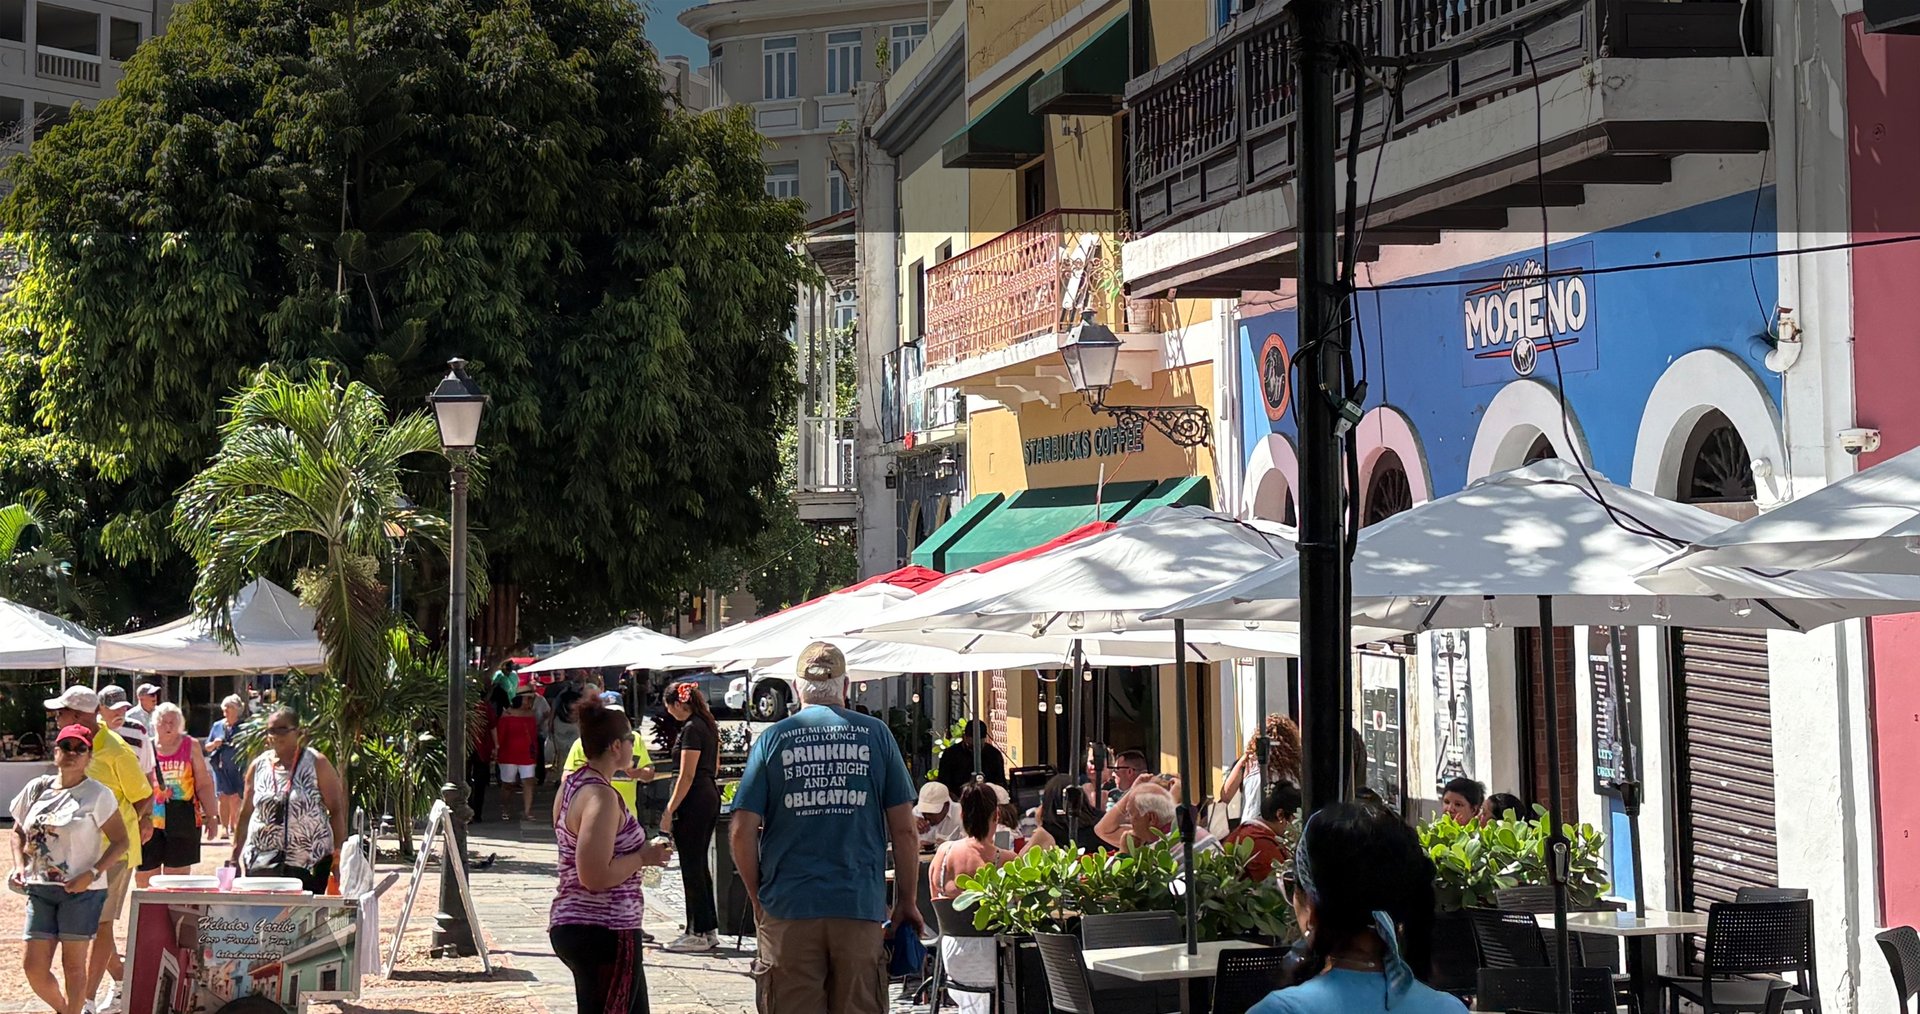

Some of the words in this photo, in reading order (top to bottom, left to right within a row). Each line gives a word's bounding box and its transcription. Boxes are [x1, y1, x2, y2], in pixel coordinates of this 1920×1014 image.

[1464, 276, 1587, 350] MORENO
[1024, 428, 1092, 465] STARBUCKS
[1094, 417, 1144, 457] COFFEE
[780, 727, 807, 739] WHITE
[808, 725, 849, 735] MEADOW
[851, 725, 870, 735] LAKE
[821, 732, 857, 741] LOUNGE
[781, 743, 870, 766] DRINKING
[783, 767, 794, 780] IS
[796, 763, 825, 777] BOTH
[827, 762, 835, 776] A
[836, 762, 870, 776] RIGHT
[803, 777, 829, 789] AND
[829, 776, 846, 787] AN
[784, 789, 867, 808] OBLIGATION
[198, 916, 249, 931] Helados
[253, 918, 296, 934] Caribe
